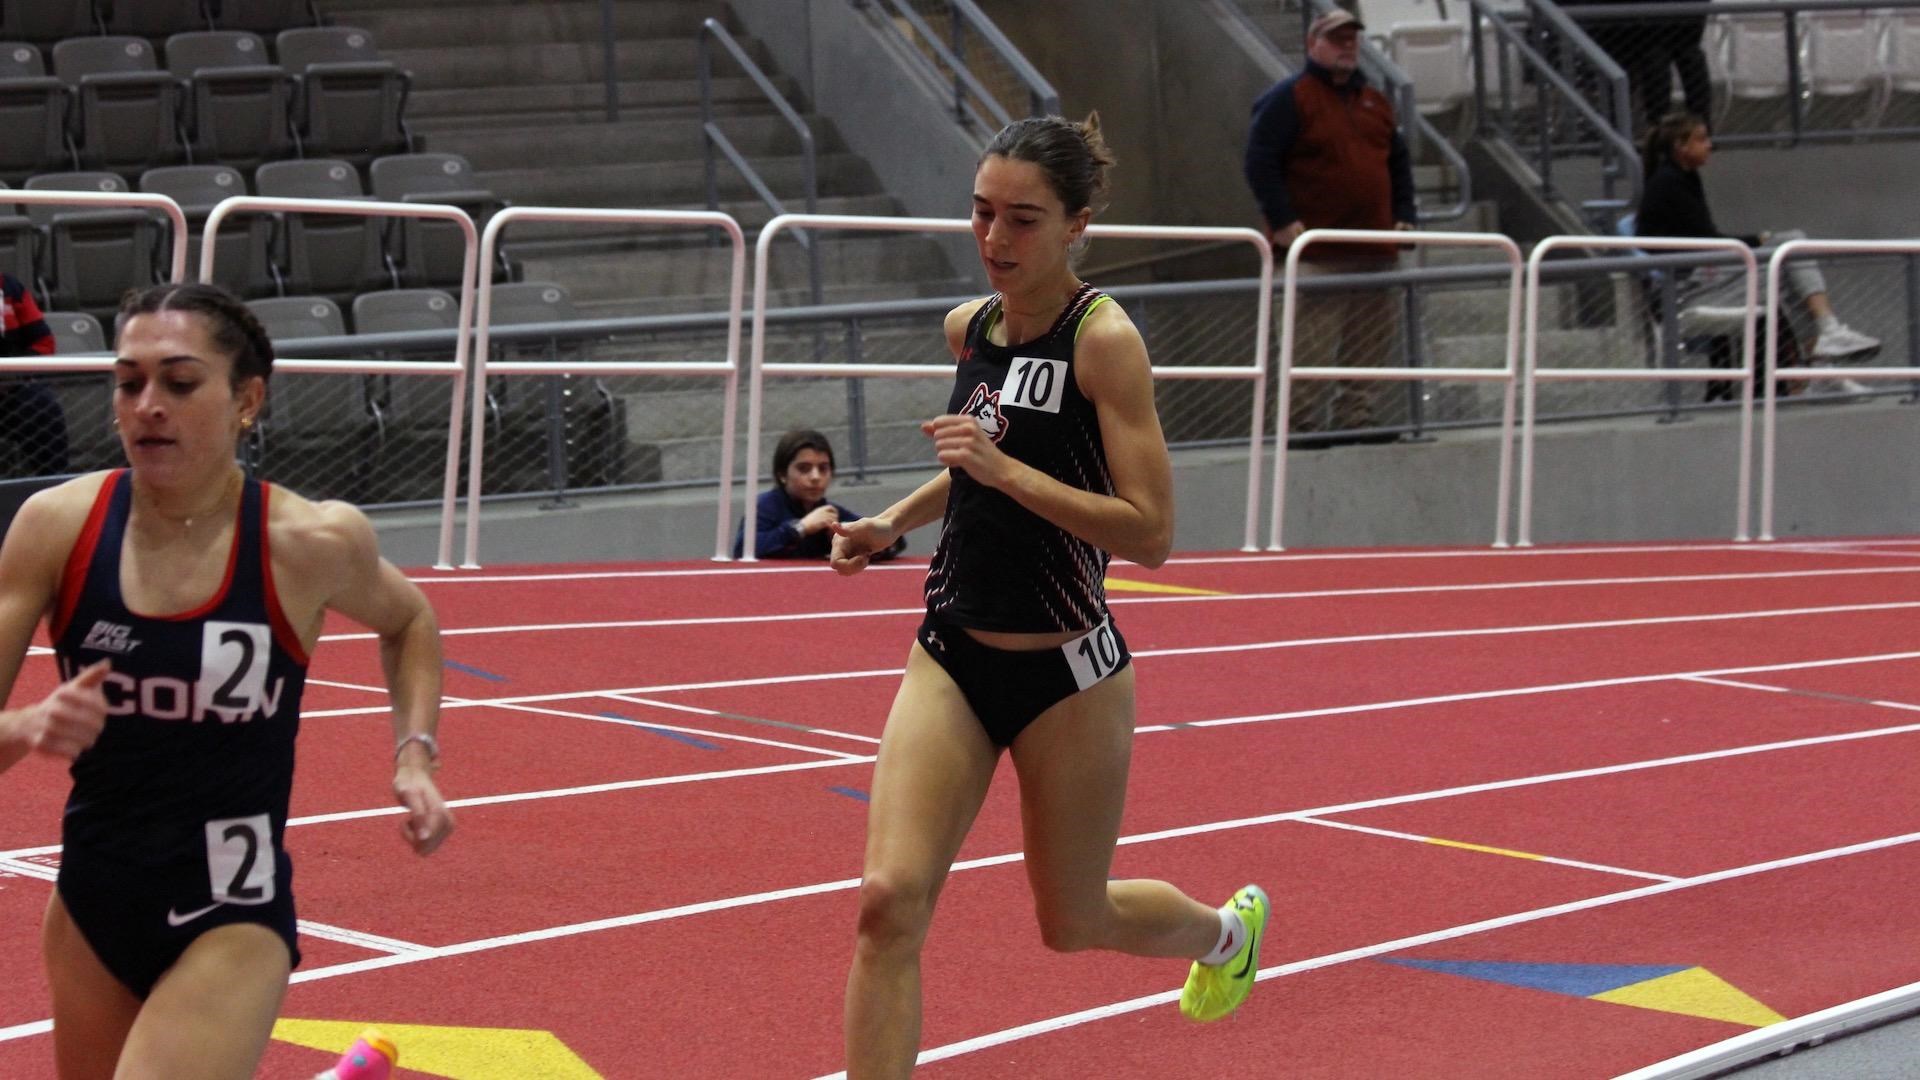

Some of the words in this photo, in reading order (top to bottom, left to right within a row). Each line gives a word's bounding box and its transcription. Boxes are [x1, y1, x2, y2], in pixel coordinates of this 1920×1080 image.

[1015, 361, 1055, 407] 10
[80, 633, 142, 653] EAST
[89, 620, 132, 639] BIG
[1079, 626, 1116, 678] 10
[213, 629, 255, 708] 2
[223, 824, 263, 899] 2
